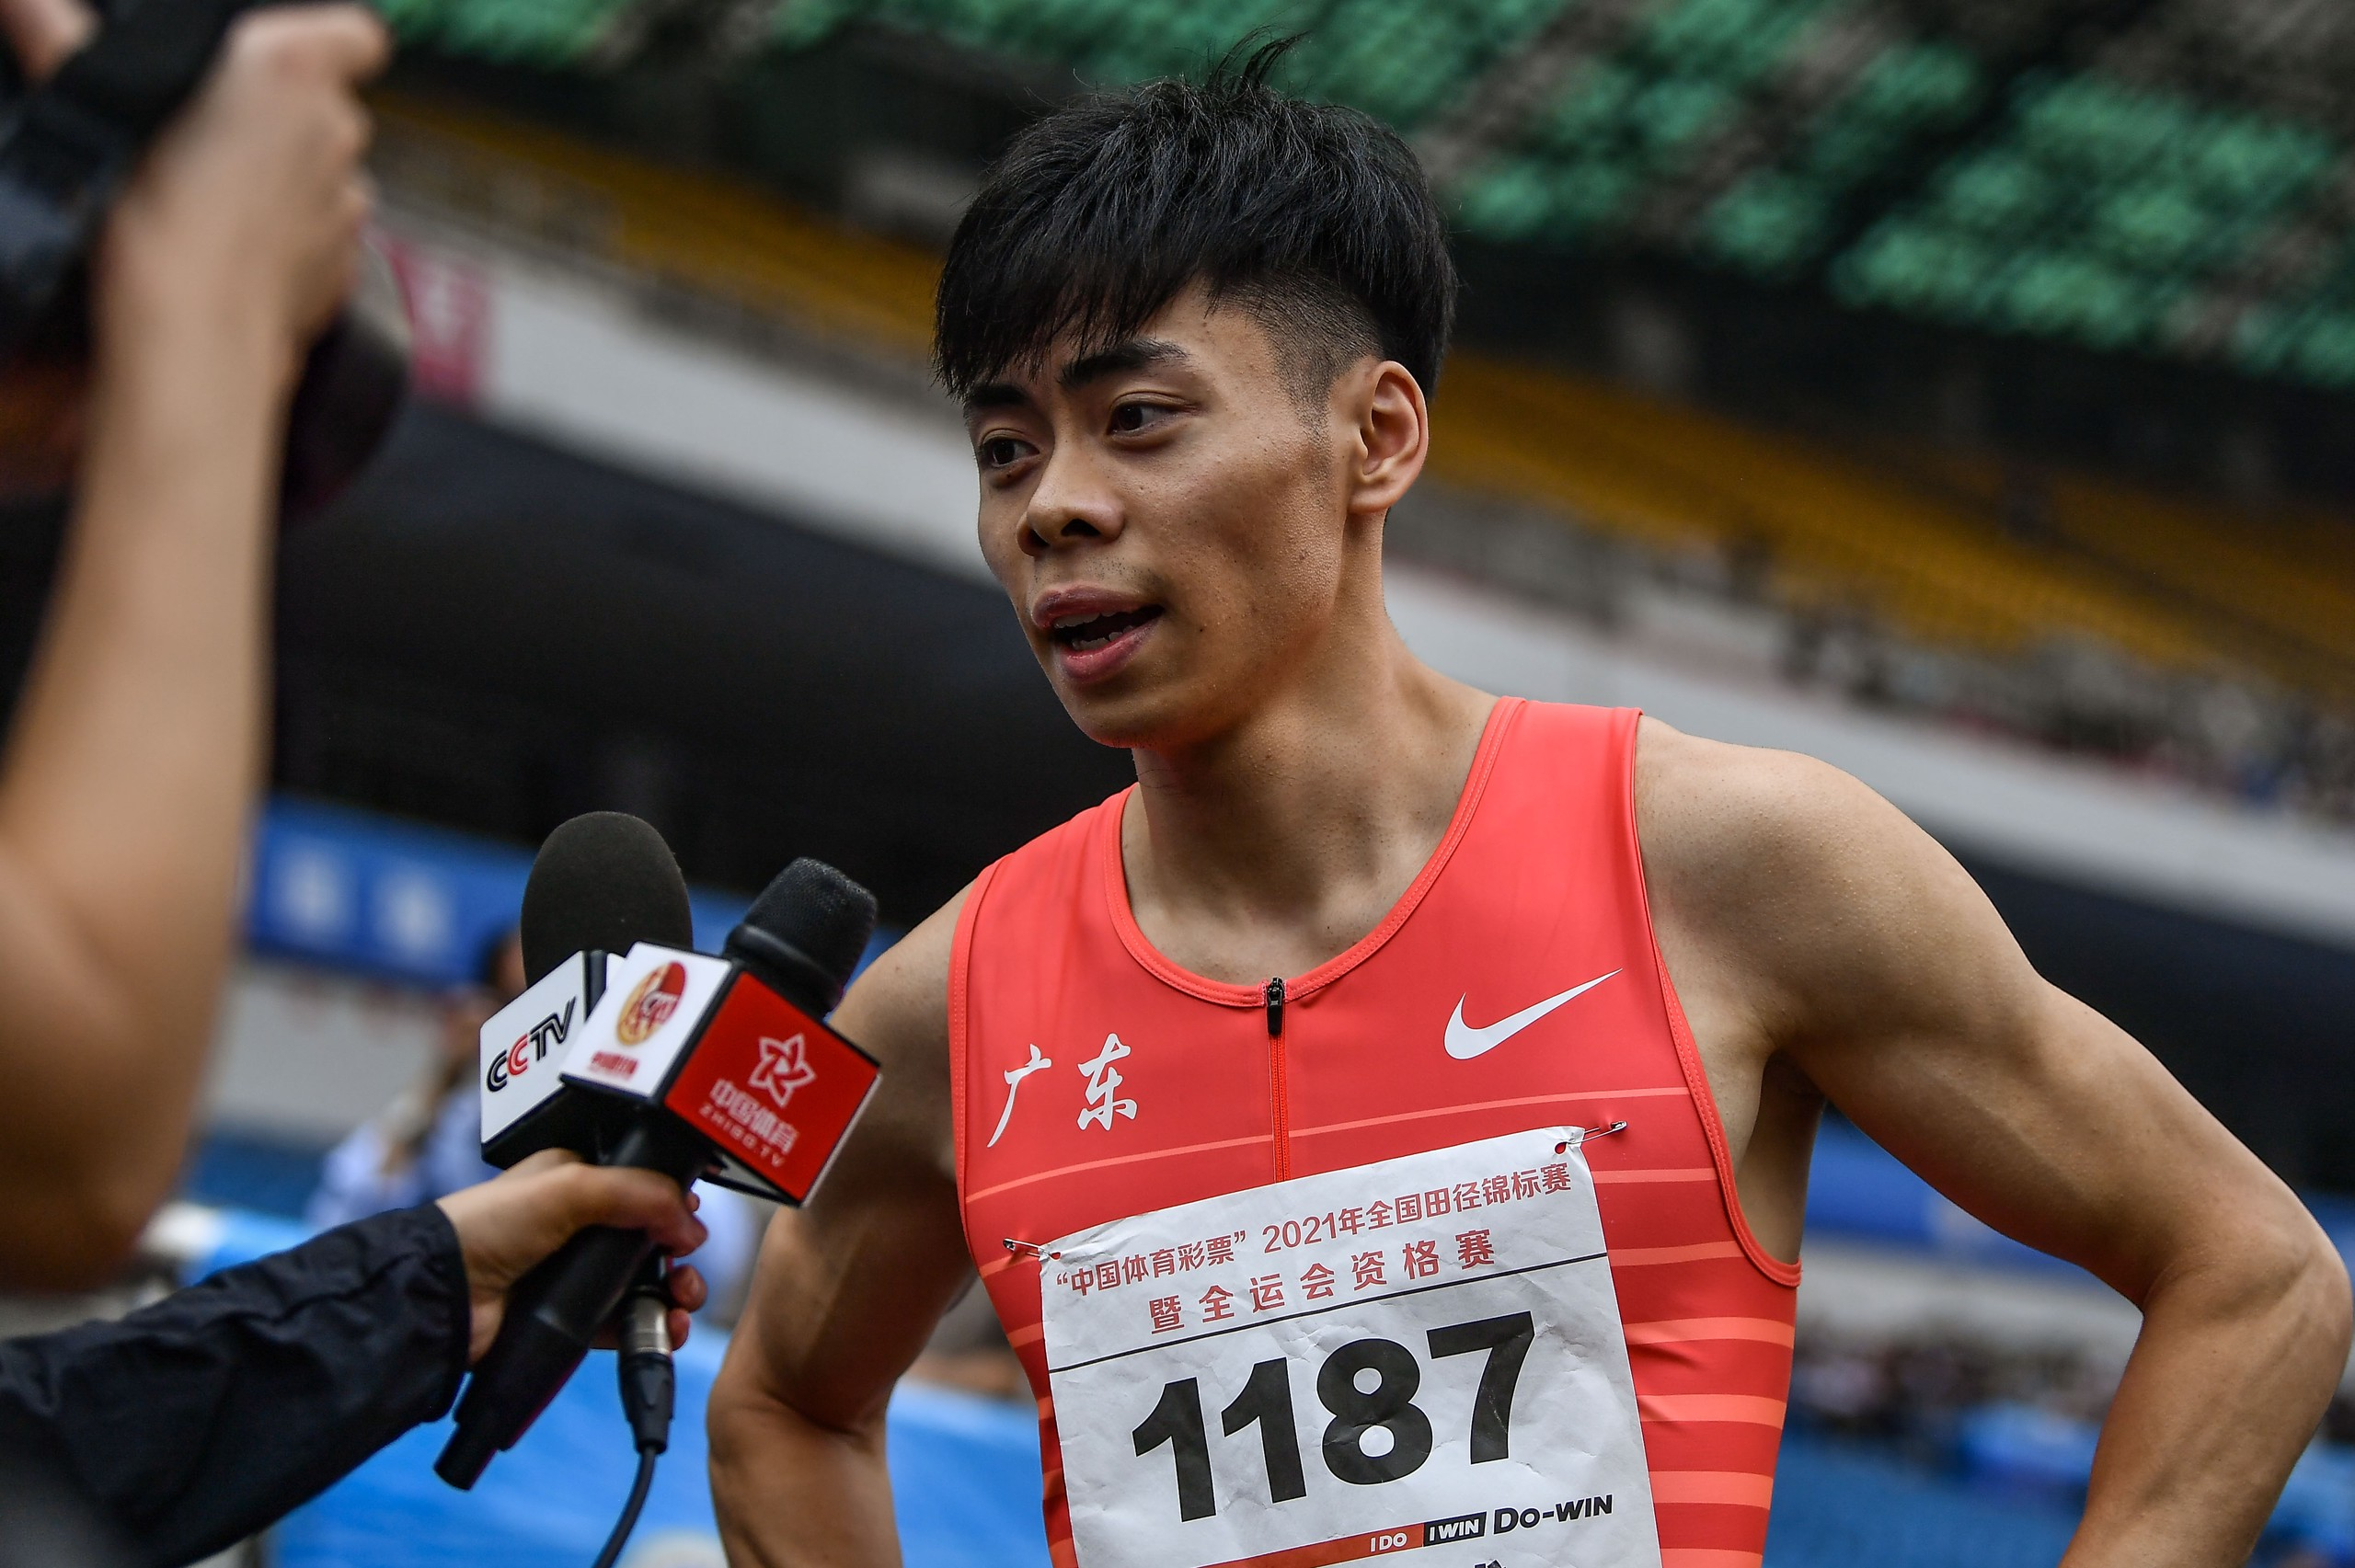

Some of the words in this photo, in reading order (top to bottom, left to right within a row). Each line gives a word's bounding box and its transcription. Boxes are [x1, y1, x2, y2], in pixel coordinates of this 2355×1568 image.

[487, 995, 577, 1093] CCTV
[987, 1033, 1138, 1148] 广东
[1263, 1162, 1571, 1253] 2021年全国田径锦标赛
[1149, 1229, 1496, 1334] 暨全运会资格赛
[1132, 1310, 1535, 1523] 1187
[1380, 1532, 1407, 1551] DO
[1438, 1518, 1479, 1539] WIN
